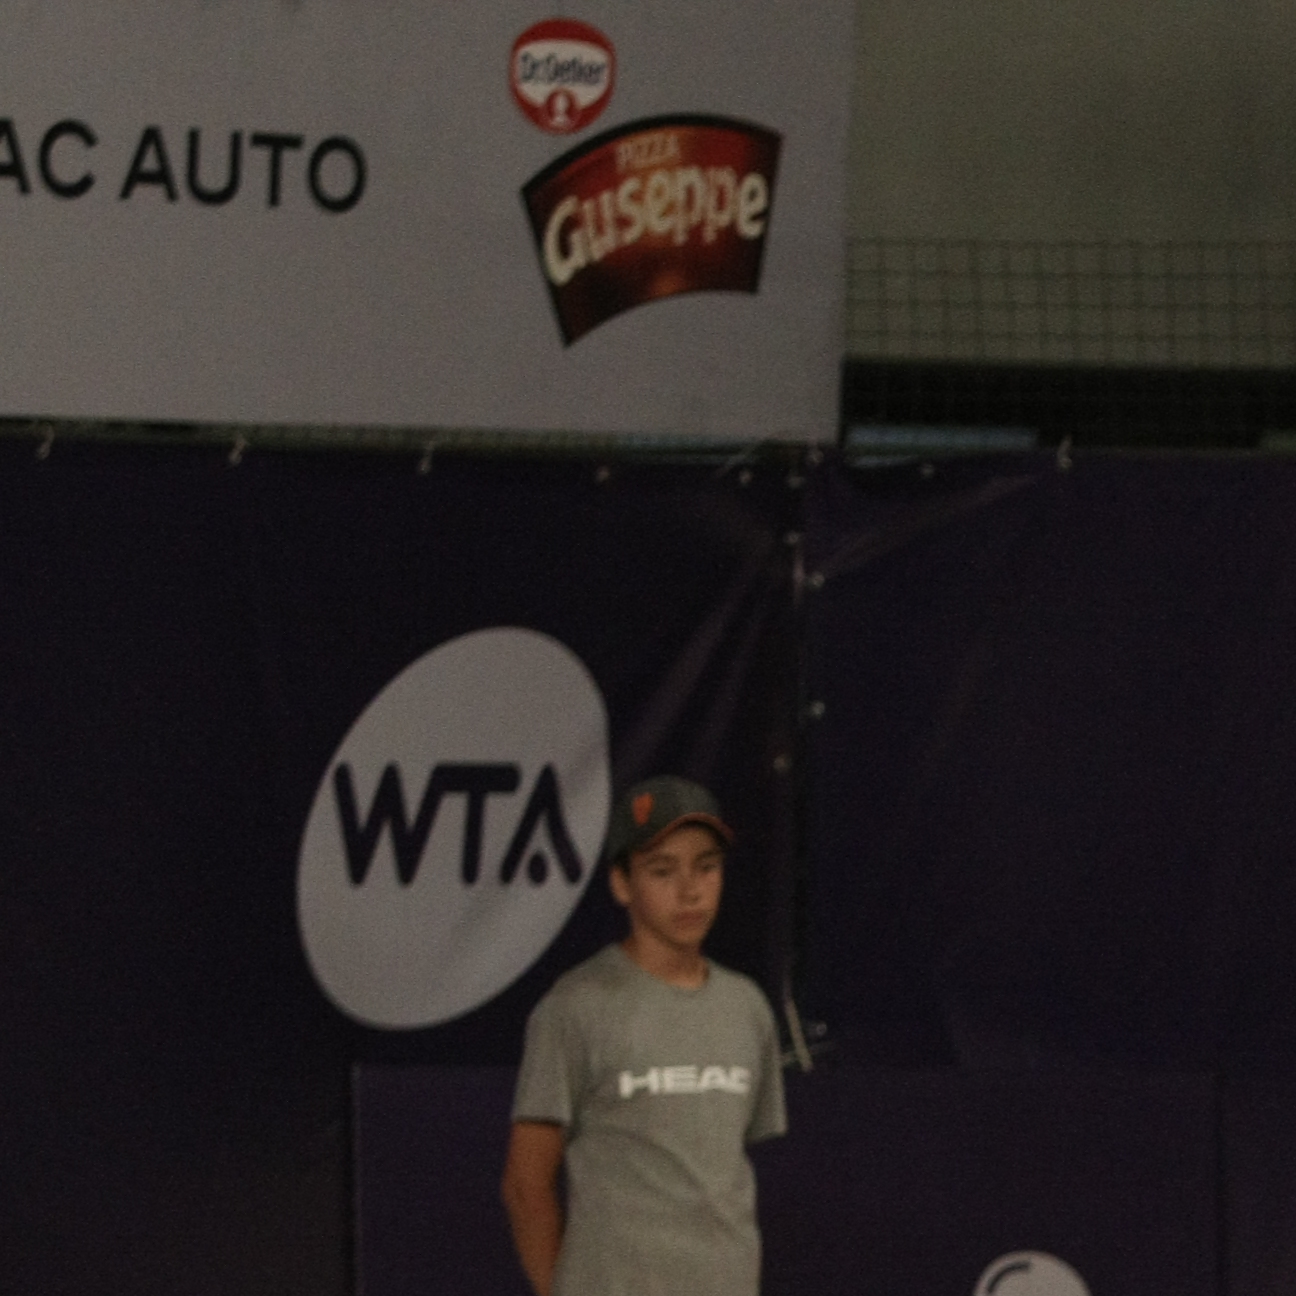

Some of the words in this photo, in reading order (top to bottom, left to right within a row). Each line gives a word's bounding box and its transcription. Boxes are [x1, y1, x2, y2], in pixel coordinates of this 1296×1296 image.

[118, 124, 368, 214] AUTO
[542, 166, 769, 287] Guseppe
[332, 761, 584, 888] WTA
